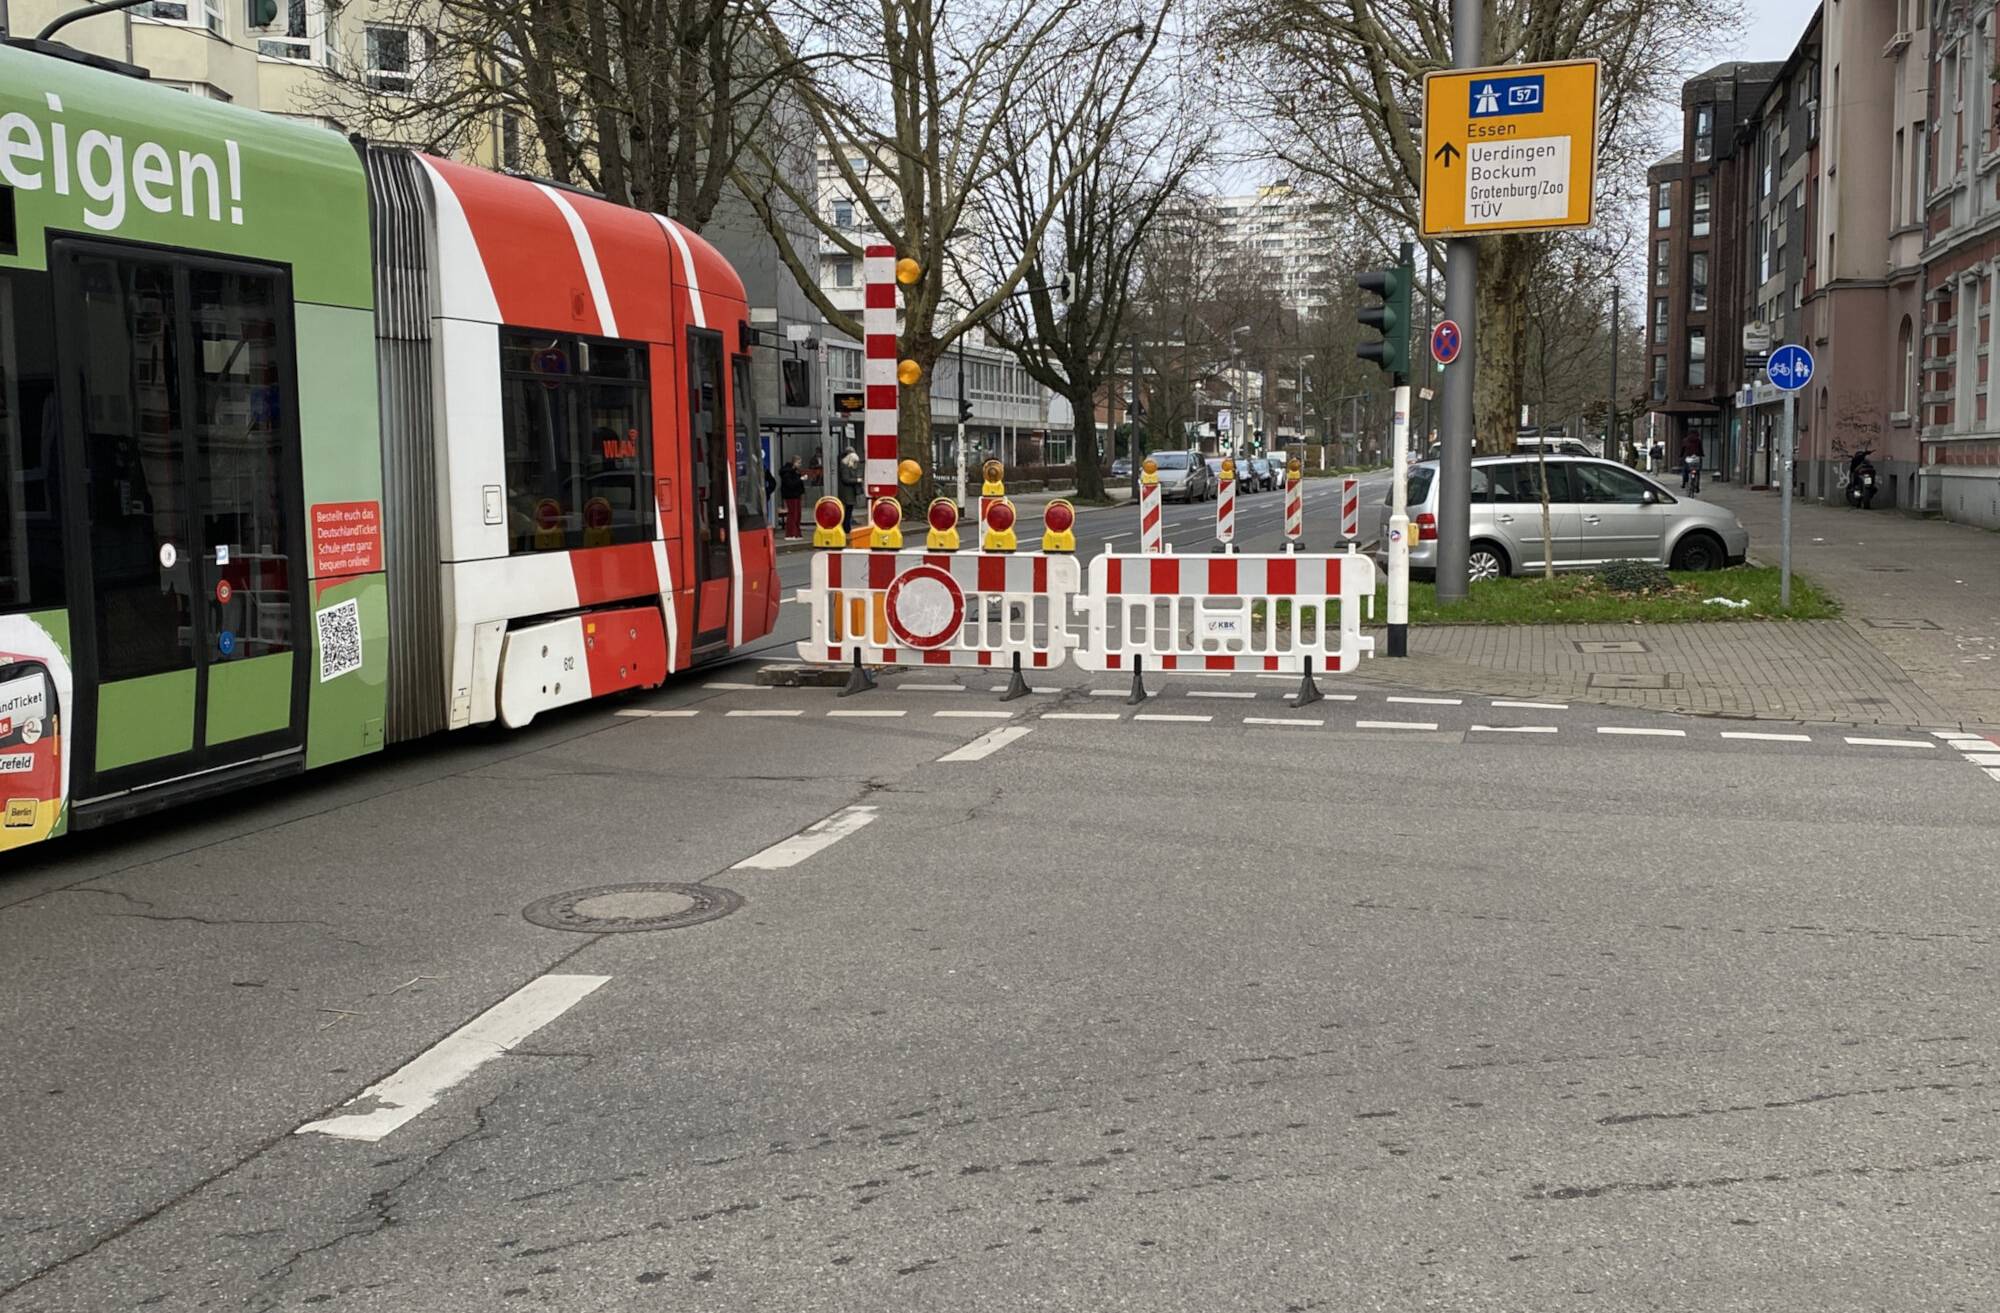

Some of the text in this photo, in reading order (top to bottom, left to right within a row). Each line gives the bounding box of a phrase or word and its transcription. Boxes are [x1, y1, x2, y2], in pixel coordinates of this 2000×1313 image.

[1516, 89, 1531, 101] 57
[1467, 123, 1516, 138] Essen
[1471, 144, 1556, 162] Uerdingen
[1471, 164, 1536, 181] Bockum
[1470, 180, 1564, 200] Grotenburg/Zoo
[1471, 201, 1502, 218] TÜV
[603, 440, 636, 459] WLAN
[317, 509, 373, 522] Bestellt euch das
[318, 525, 376, 538] DeutschlandTicket
[319, 542, 372, 555] Schule jetzt ganz
[319, 555, 369, 572] bequem online!
[1218, 621, 1235, 629] KBK
[563, 655, 575, 671] 612
[0, 756, 32, 770] refeld
[11, 808, 32, 817] Berlin
